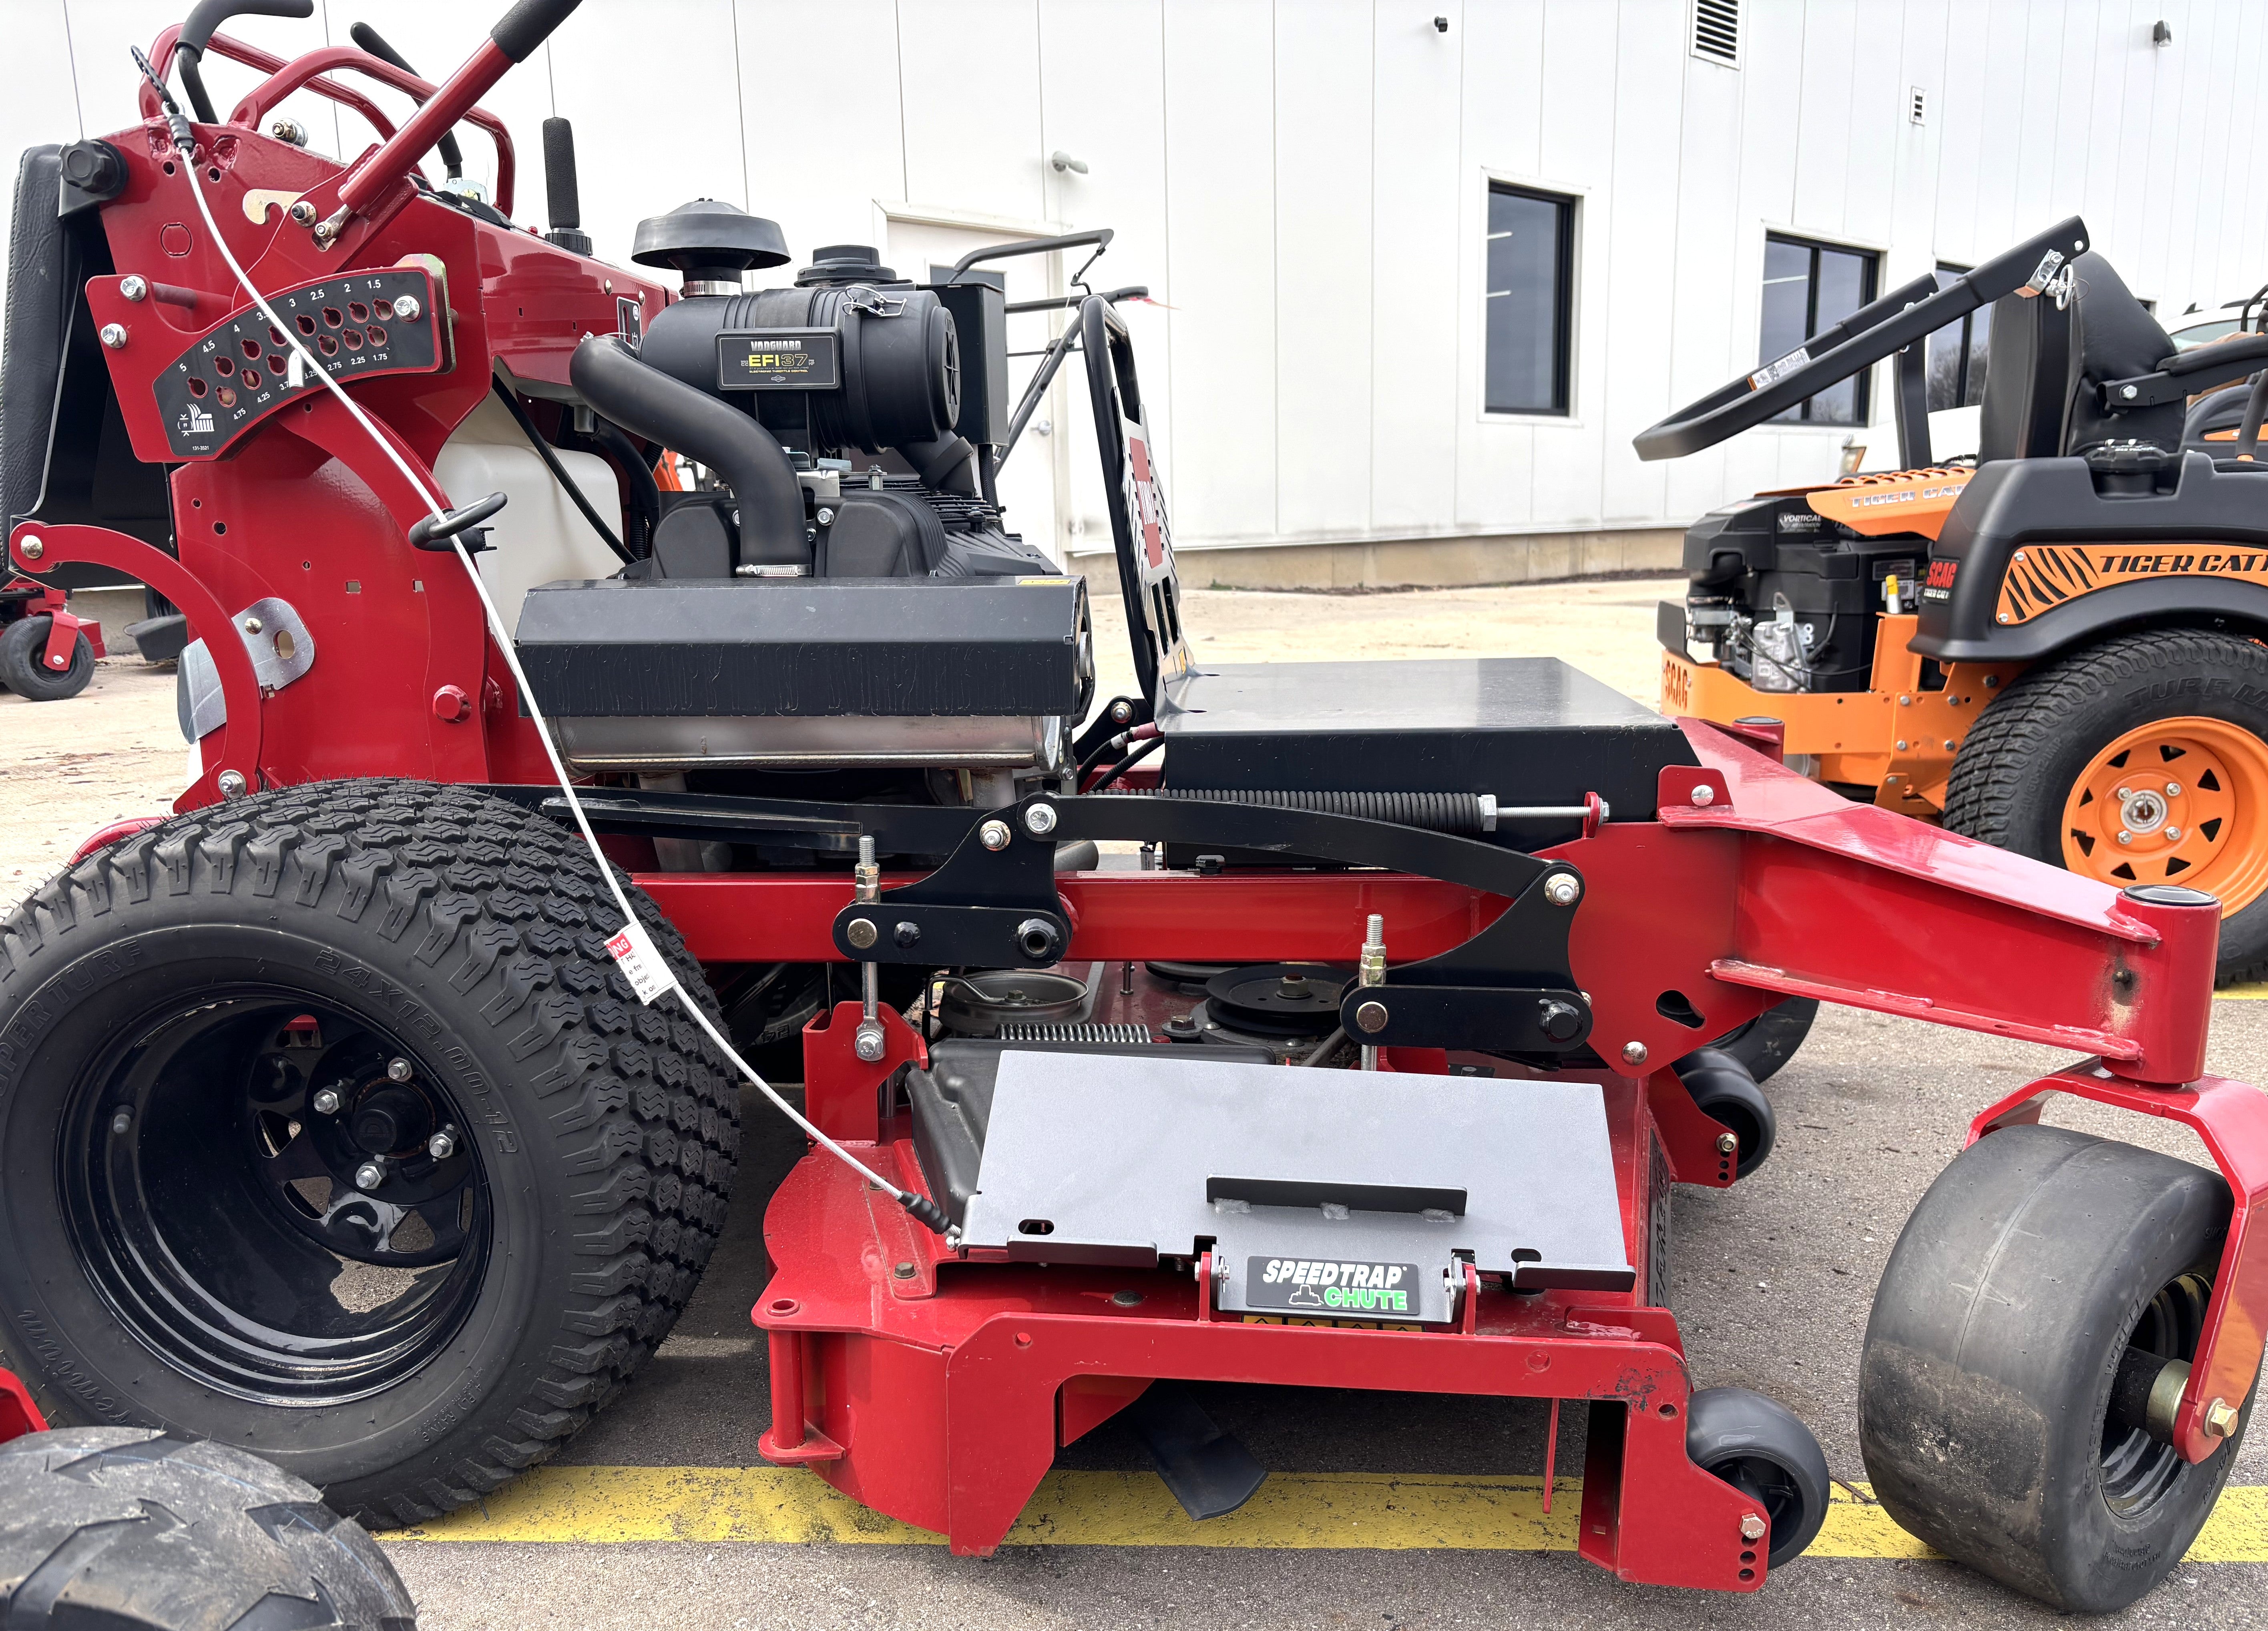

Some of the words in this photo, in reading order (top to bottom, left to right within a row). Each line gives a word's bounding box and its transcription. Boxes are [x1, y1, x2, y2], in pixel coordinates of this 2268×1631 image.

[344, 283, 351, 292] 2
[367, 279, 381, 289] 1.5
[310, 289, 325, 300] 2.5
[289, 298, 296, 307] 3
[256, 312, 269, 321] 3.
[234, 324, 240, 333] 4
[203, 340, 215, 353] 4.5
[751, 340, 802, 351] VANGUARD
[327, 361, 342, 371] 2.75
[351, 357, 366, 365] 2.25
[748, 354, 779, 367] EFI
[781, 354, 808, 367] 37
[179, 363, 187, 372] 5
[279, 381, 289, 391] 3.7
[257, 391, 271, 403] 4.25
[233, 408, 246, 420] 4.75
[1849, 491, 1916, 508] TIGER
[1784, 514, 1822, 522] VORTICAL
[2099, 555, 2194, 573] TIGER
[2198, 554, 2264, 572] CAT
[1926, 561, 1957, 589] SCAG
[1665, 660, 1687, 711] SCAG
[2123, 676, 2231, 710] TURF
[45, 940, 141, 1004] TURF
[1262, 1259, 1402, 1288] SPEEDTRAP
[1323, 1286, 1408, 1310] CHUTE
[17, 1310, 155, 1427] remium
[458, 1392, 476, 1410] PLY
